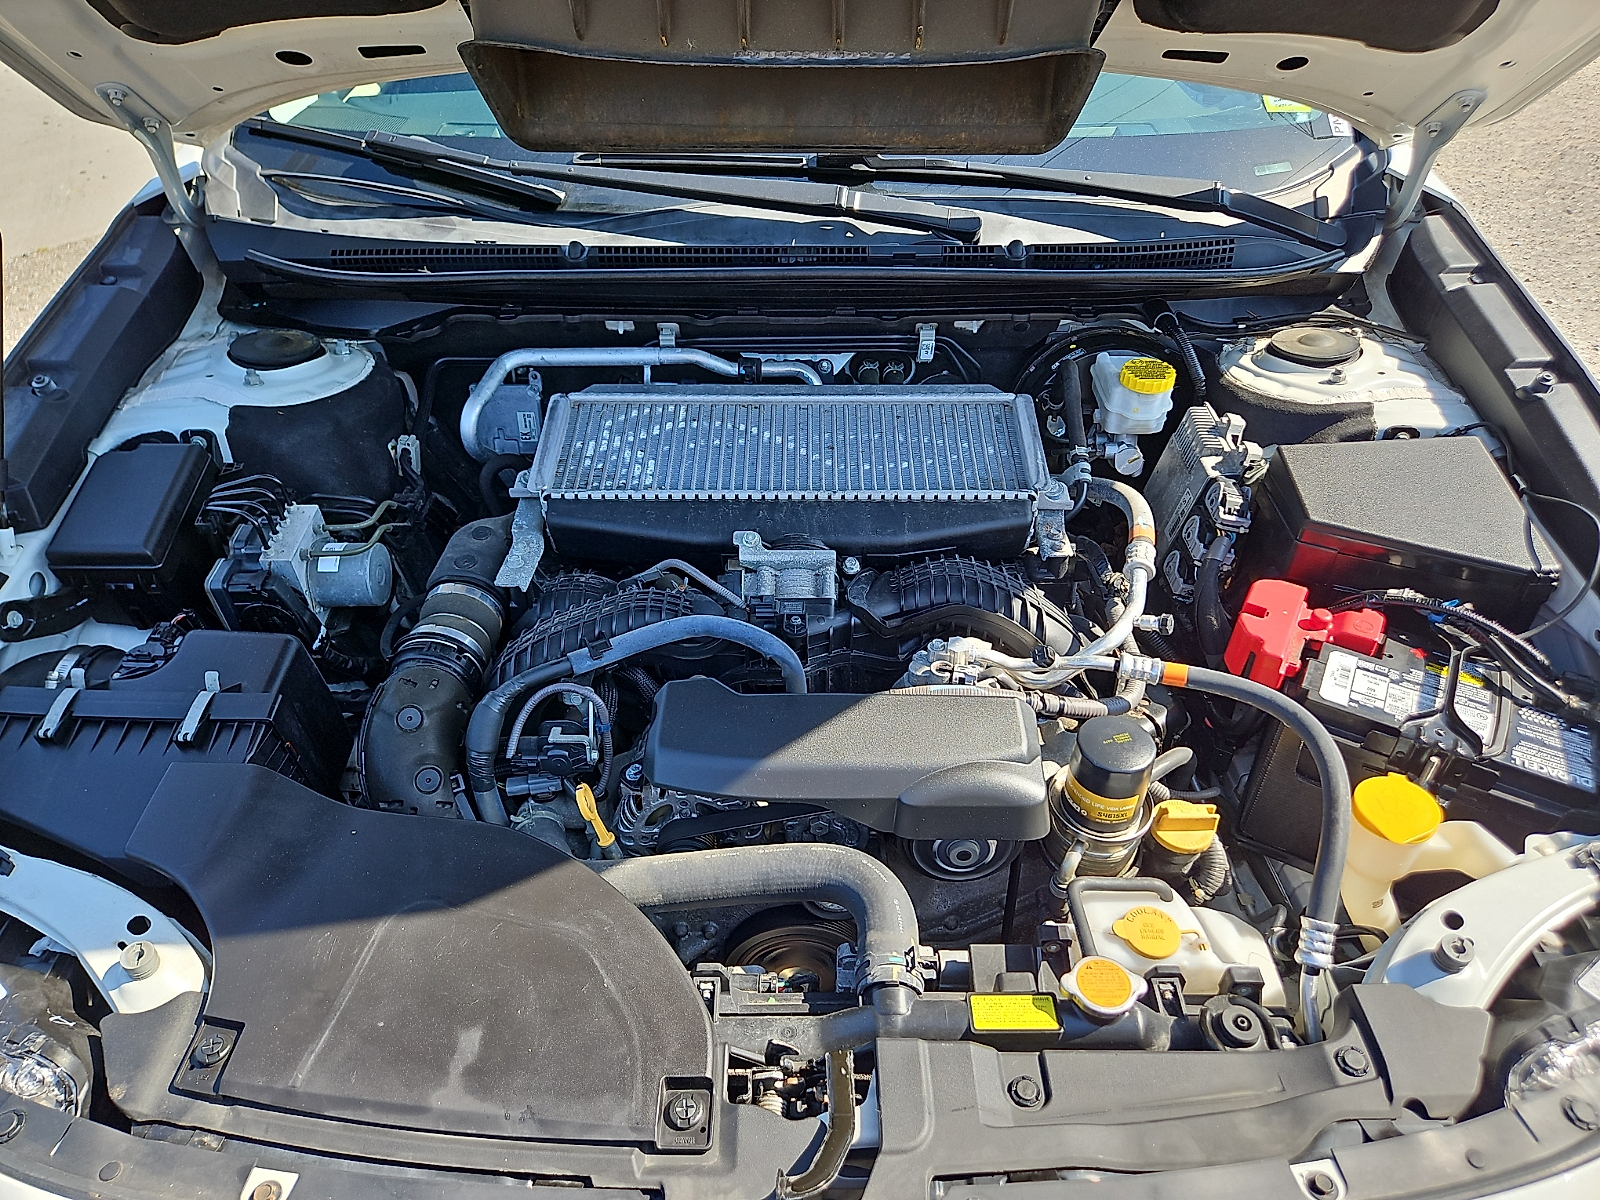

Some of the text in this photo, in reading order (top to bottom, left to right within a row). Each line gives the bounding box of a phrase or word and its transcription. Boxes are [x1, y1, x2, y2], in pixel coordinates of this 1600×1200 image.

[1514, 758, 1593, 787] DURACELL
[1091, 801, 1105, 810] LIFE
[1126, 908, 1173, 923] COOLANT
